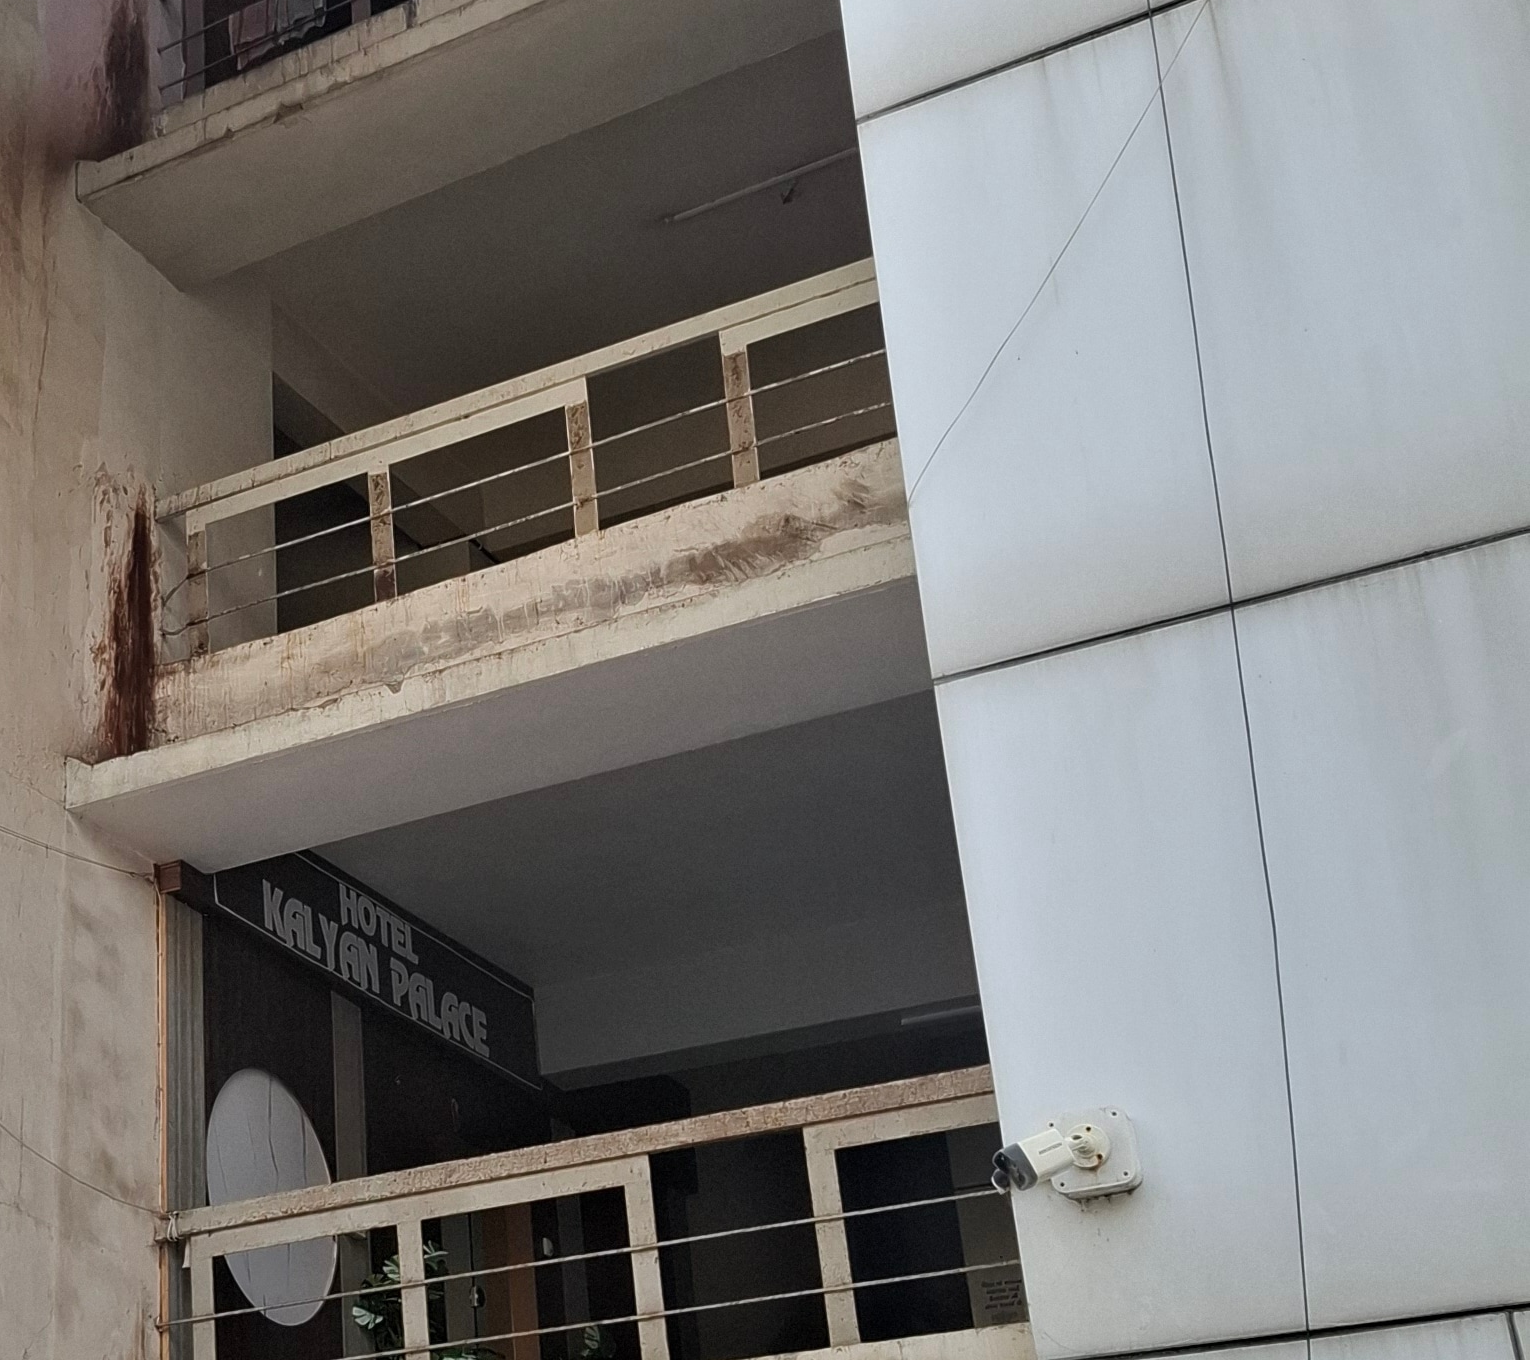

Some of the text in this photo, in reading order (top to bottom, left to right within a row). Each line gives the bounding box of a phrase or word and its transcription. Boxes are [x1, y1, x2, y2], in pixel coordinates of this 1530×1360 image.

[262, 878, 490, 1057] KALYAN PALACE
[338, 883, 419, 965] HOTEL
